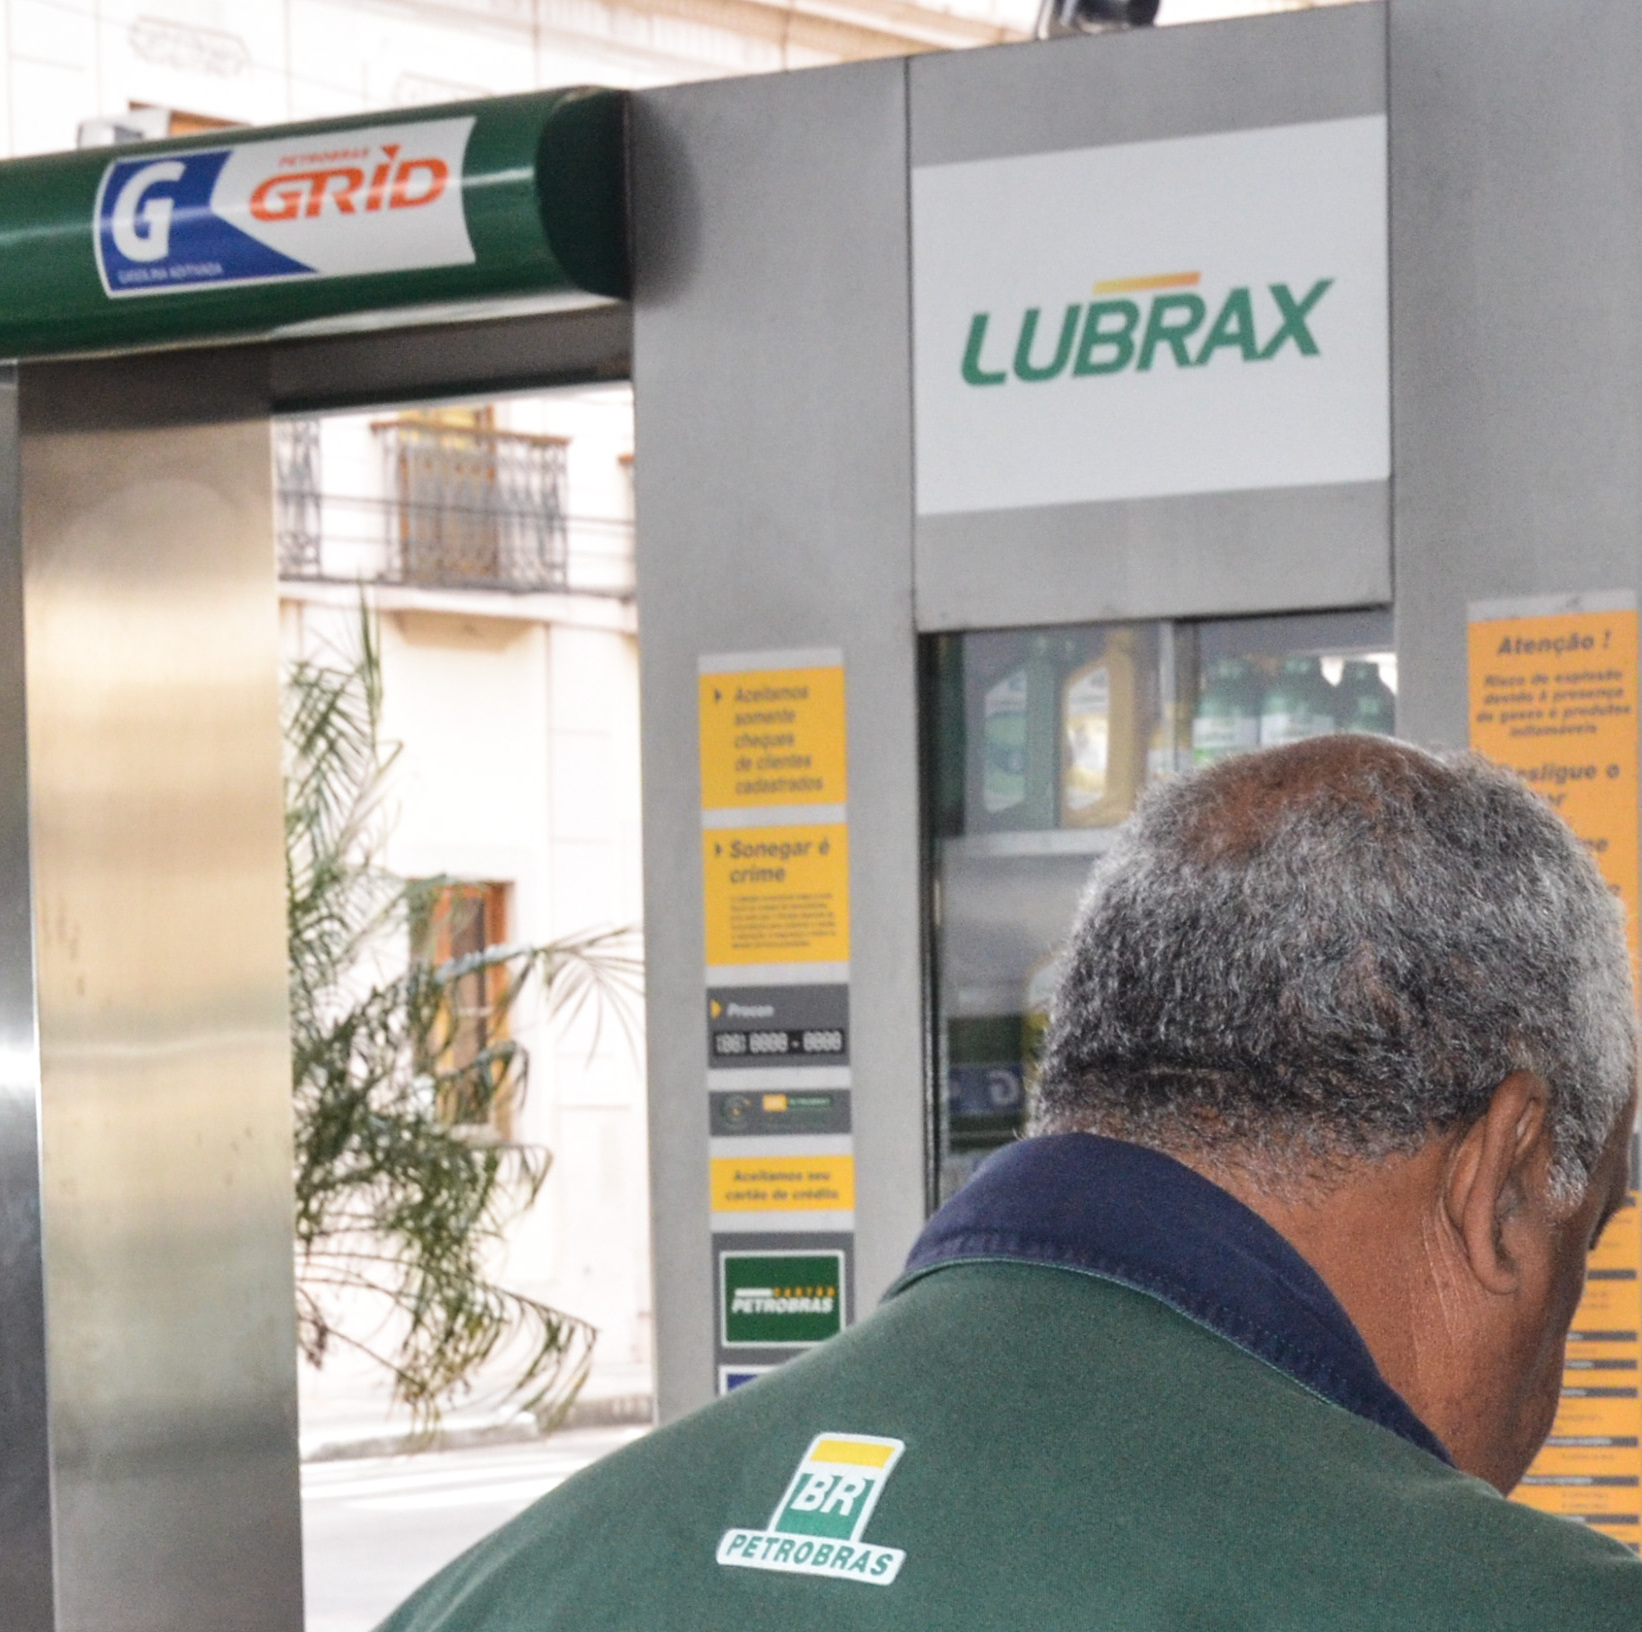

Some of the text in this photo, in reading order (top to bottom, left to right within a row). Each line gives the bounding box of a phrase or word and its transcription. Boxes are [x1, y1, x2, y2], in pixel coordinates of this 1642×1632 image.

[111, 144, 449, 263] G GRID
[961, 278, 1335, 387] LUBRAX
[1497, 632, 1595, 657] Atenção
[730, 838, 813, 860] Sonegar
[730, 865, 786, 884] crime
[731, 1297, 834, 1315] PETROBRAS
[790, 1474, 867, 1517] BR
[726, 1533, 894, 1577] PETROBRAS
